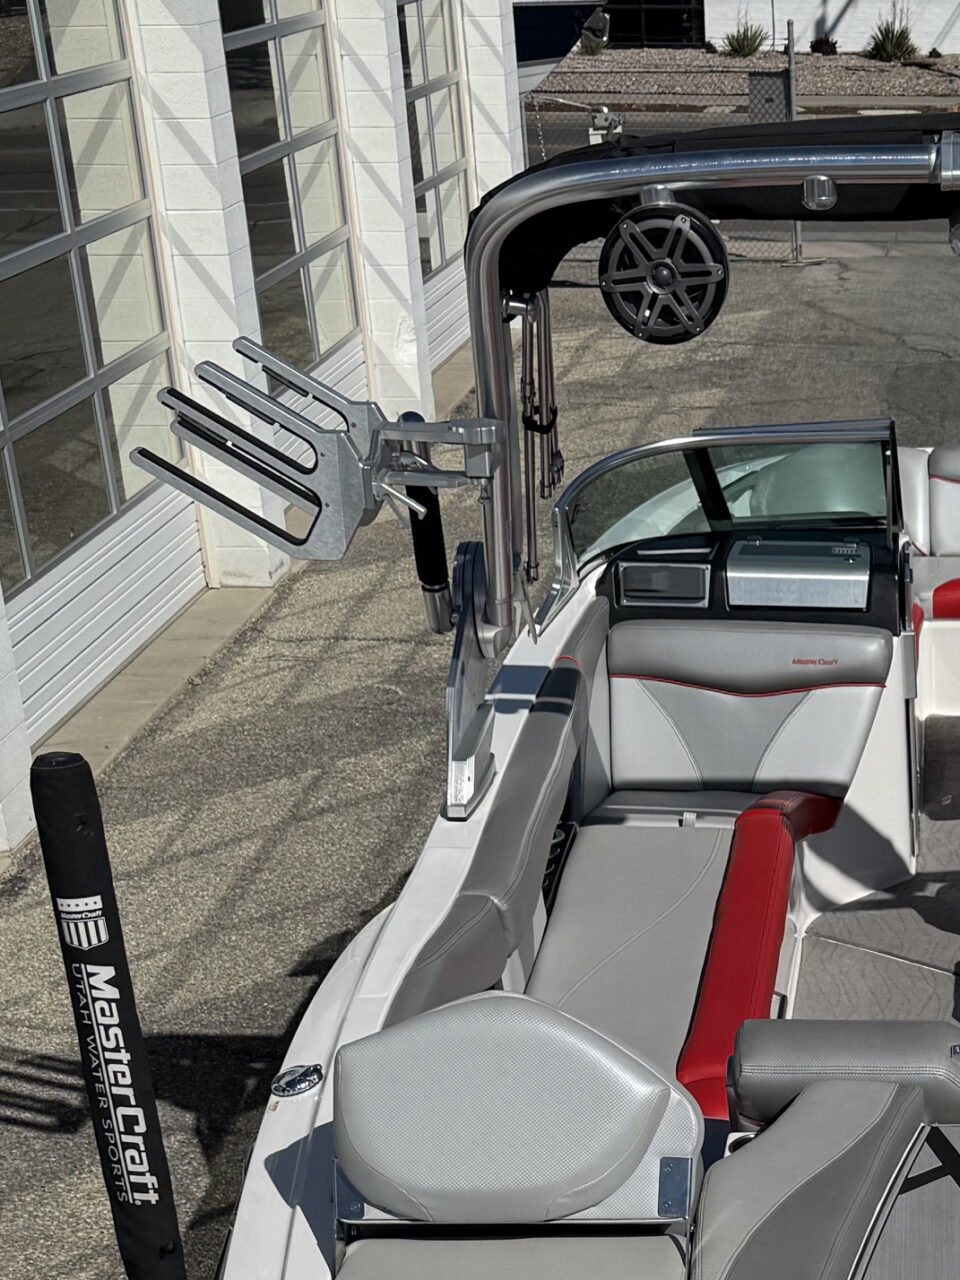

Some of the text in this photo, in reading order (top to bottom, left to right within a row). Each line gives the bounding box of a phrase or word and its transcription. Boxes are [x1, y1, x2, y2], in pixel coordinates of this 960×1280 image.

[72, 963, 128, 1202] UTAH WATER SPORTS
[86, 964, 160, 1205] MasterCraft
